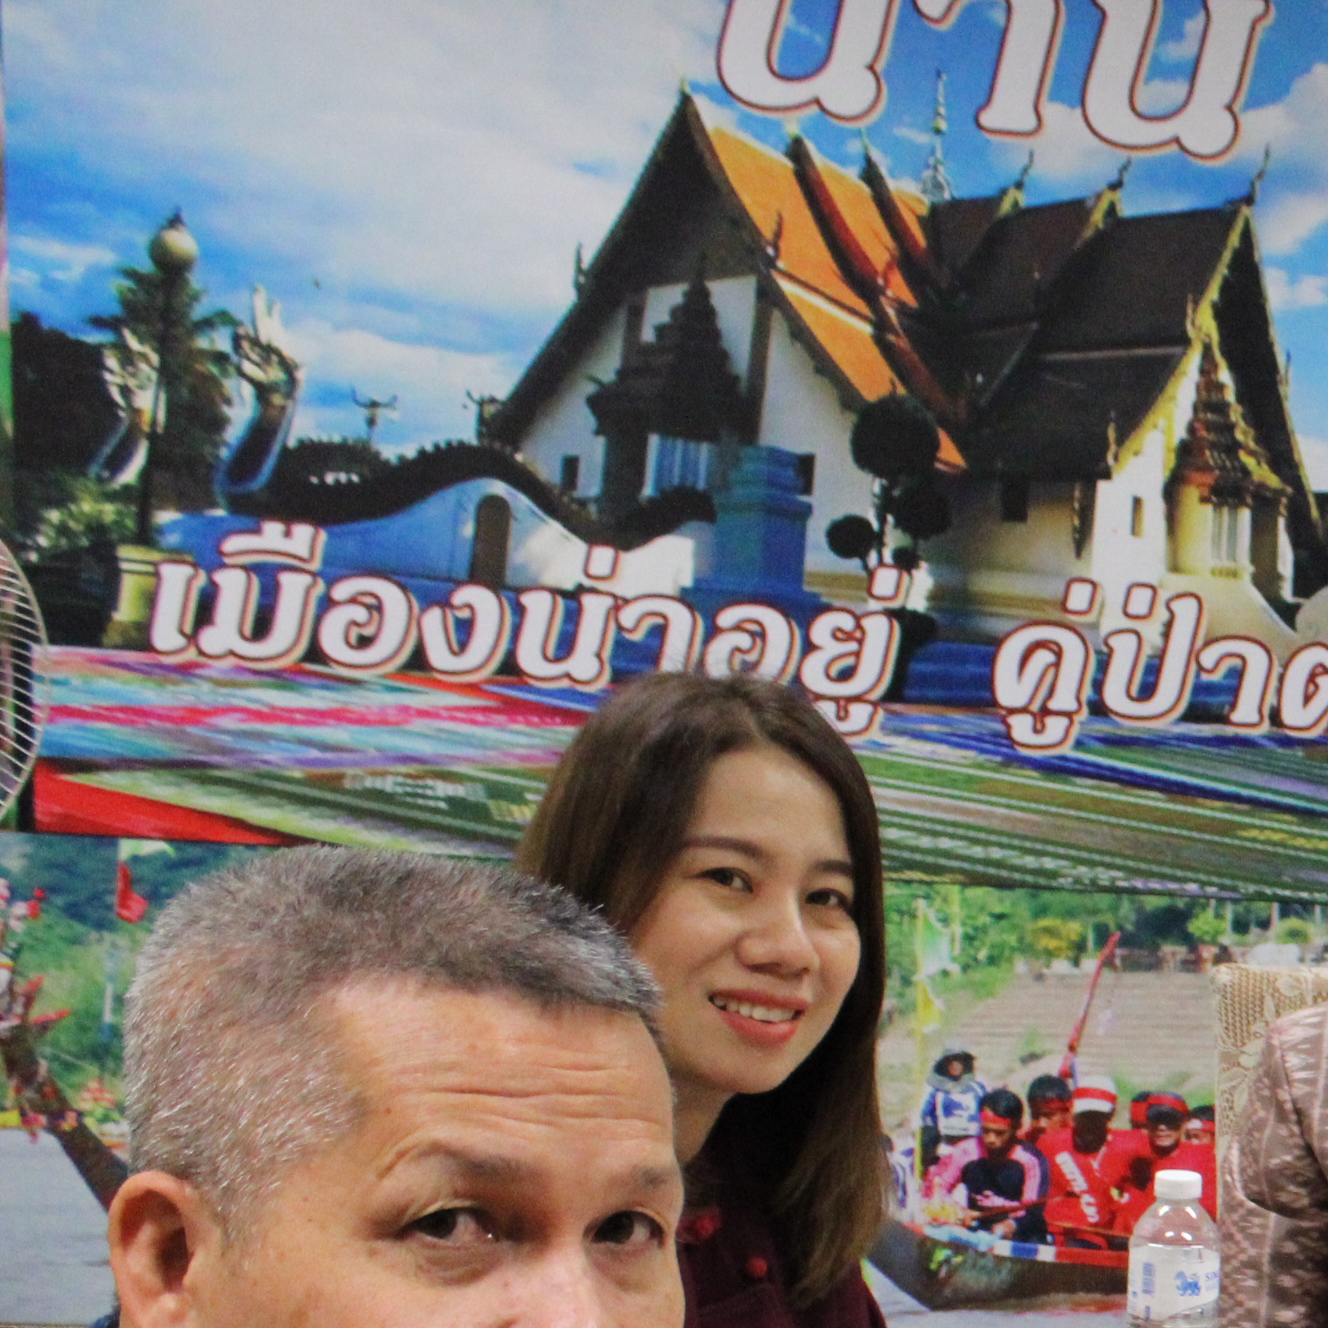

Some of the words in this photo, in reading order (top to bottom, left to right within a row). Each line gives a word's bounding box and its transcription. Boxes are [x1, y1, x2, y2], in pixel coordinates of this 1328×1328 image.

[147, 519, 903, 740] เมืองน่าอยู่
